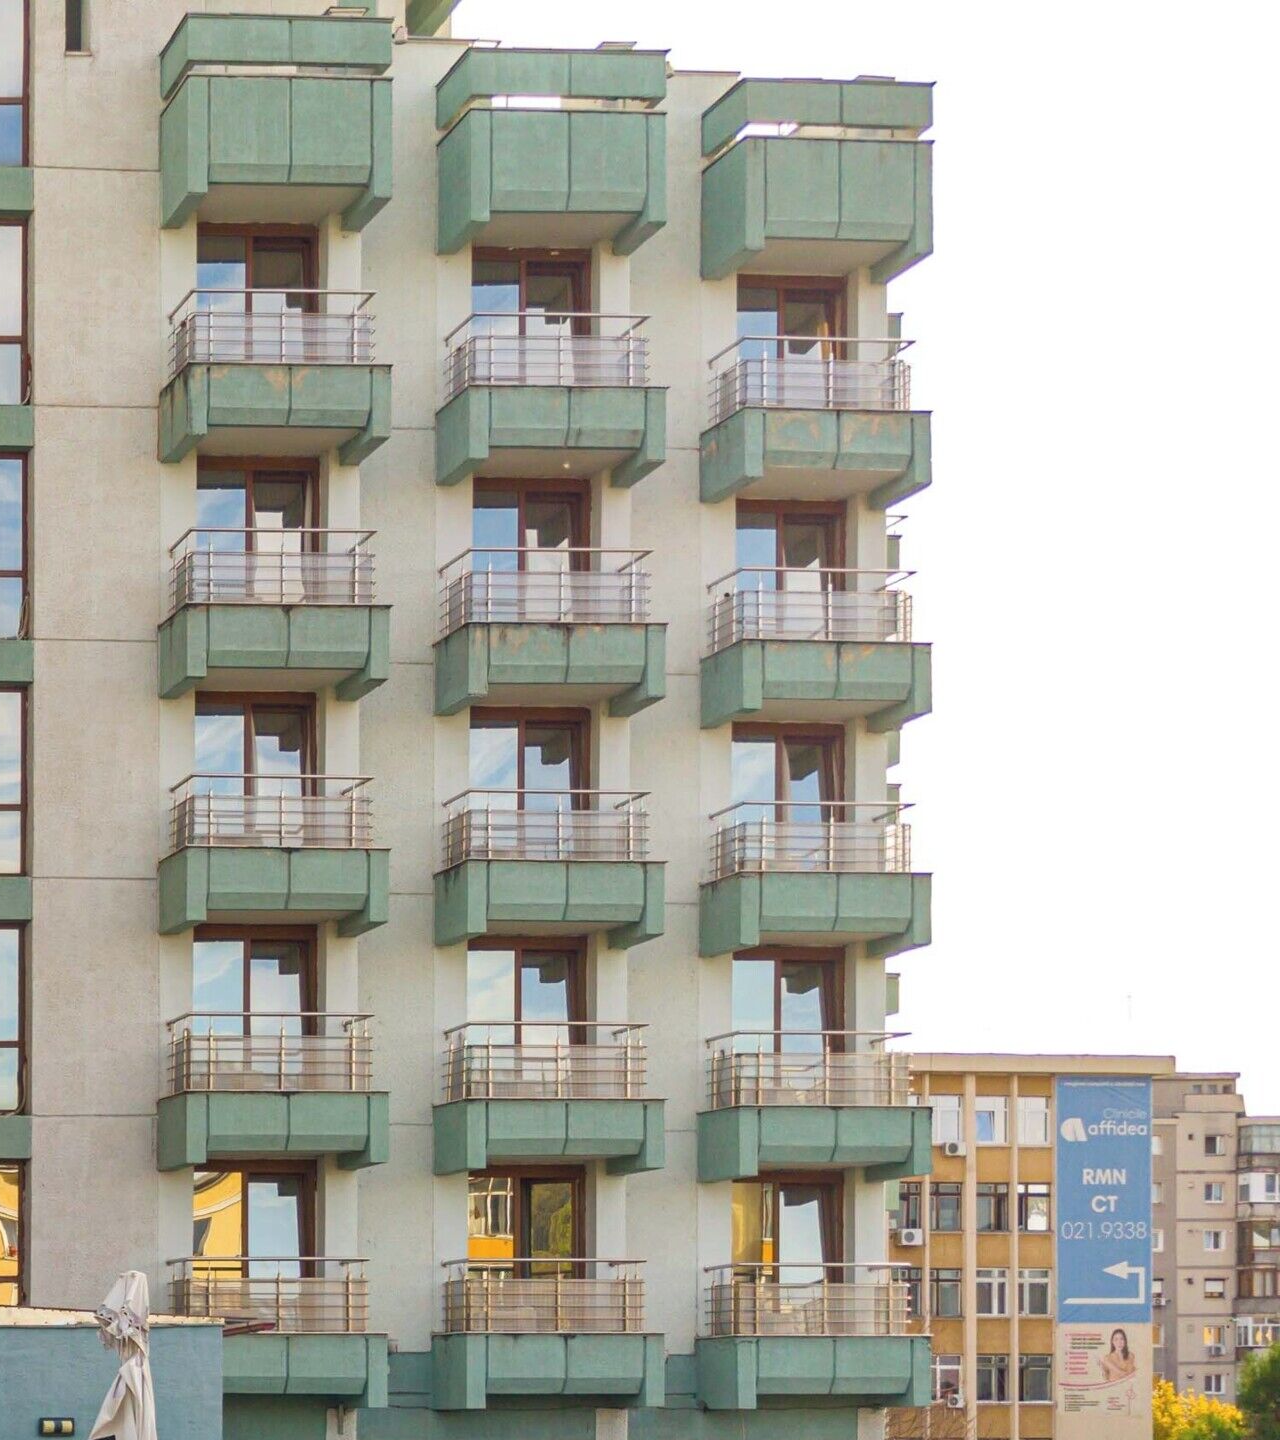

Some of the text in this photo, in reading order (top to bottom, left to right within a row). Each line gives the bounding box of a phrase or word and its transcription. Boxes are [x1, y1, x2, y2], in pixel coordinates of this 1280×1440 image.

[1088, 1120, 1147, 1136] affidea
[1082, 1168, 1127, 1185] RMN
[1091, 1195, 1119, 1213] CT
[1061, 1222, 1147, 1240] 021.9338
